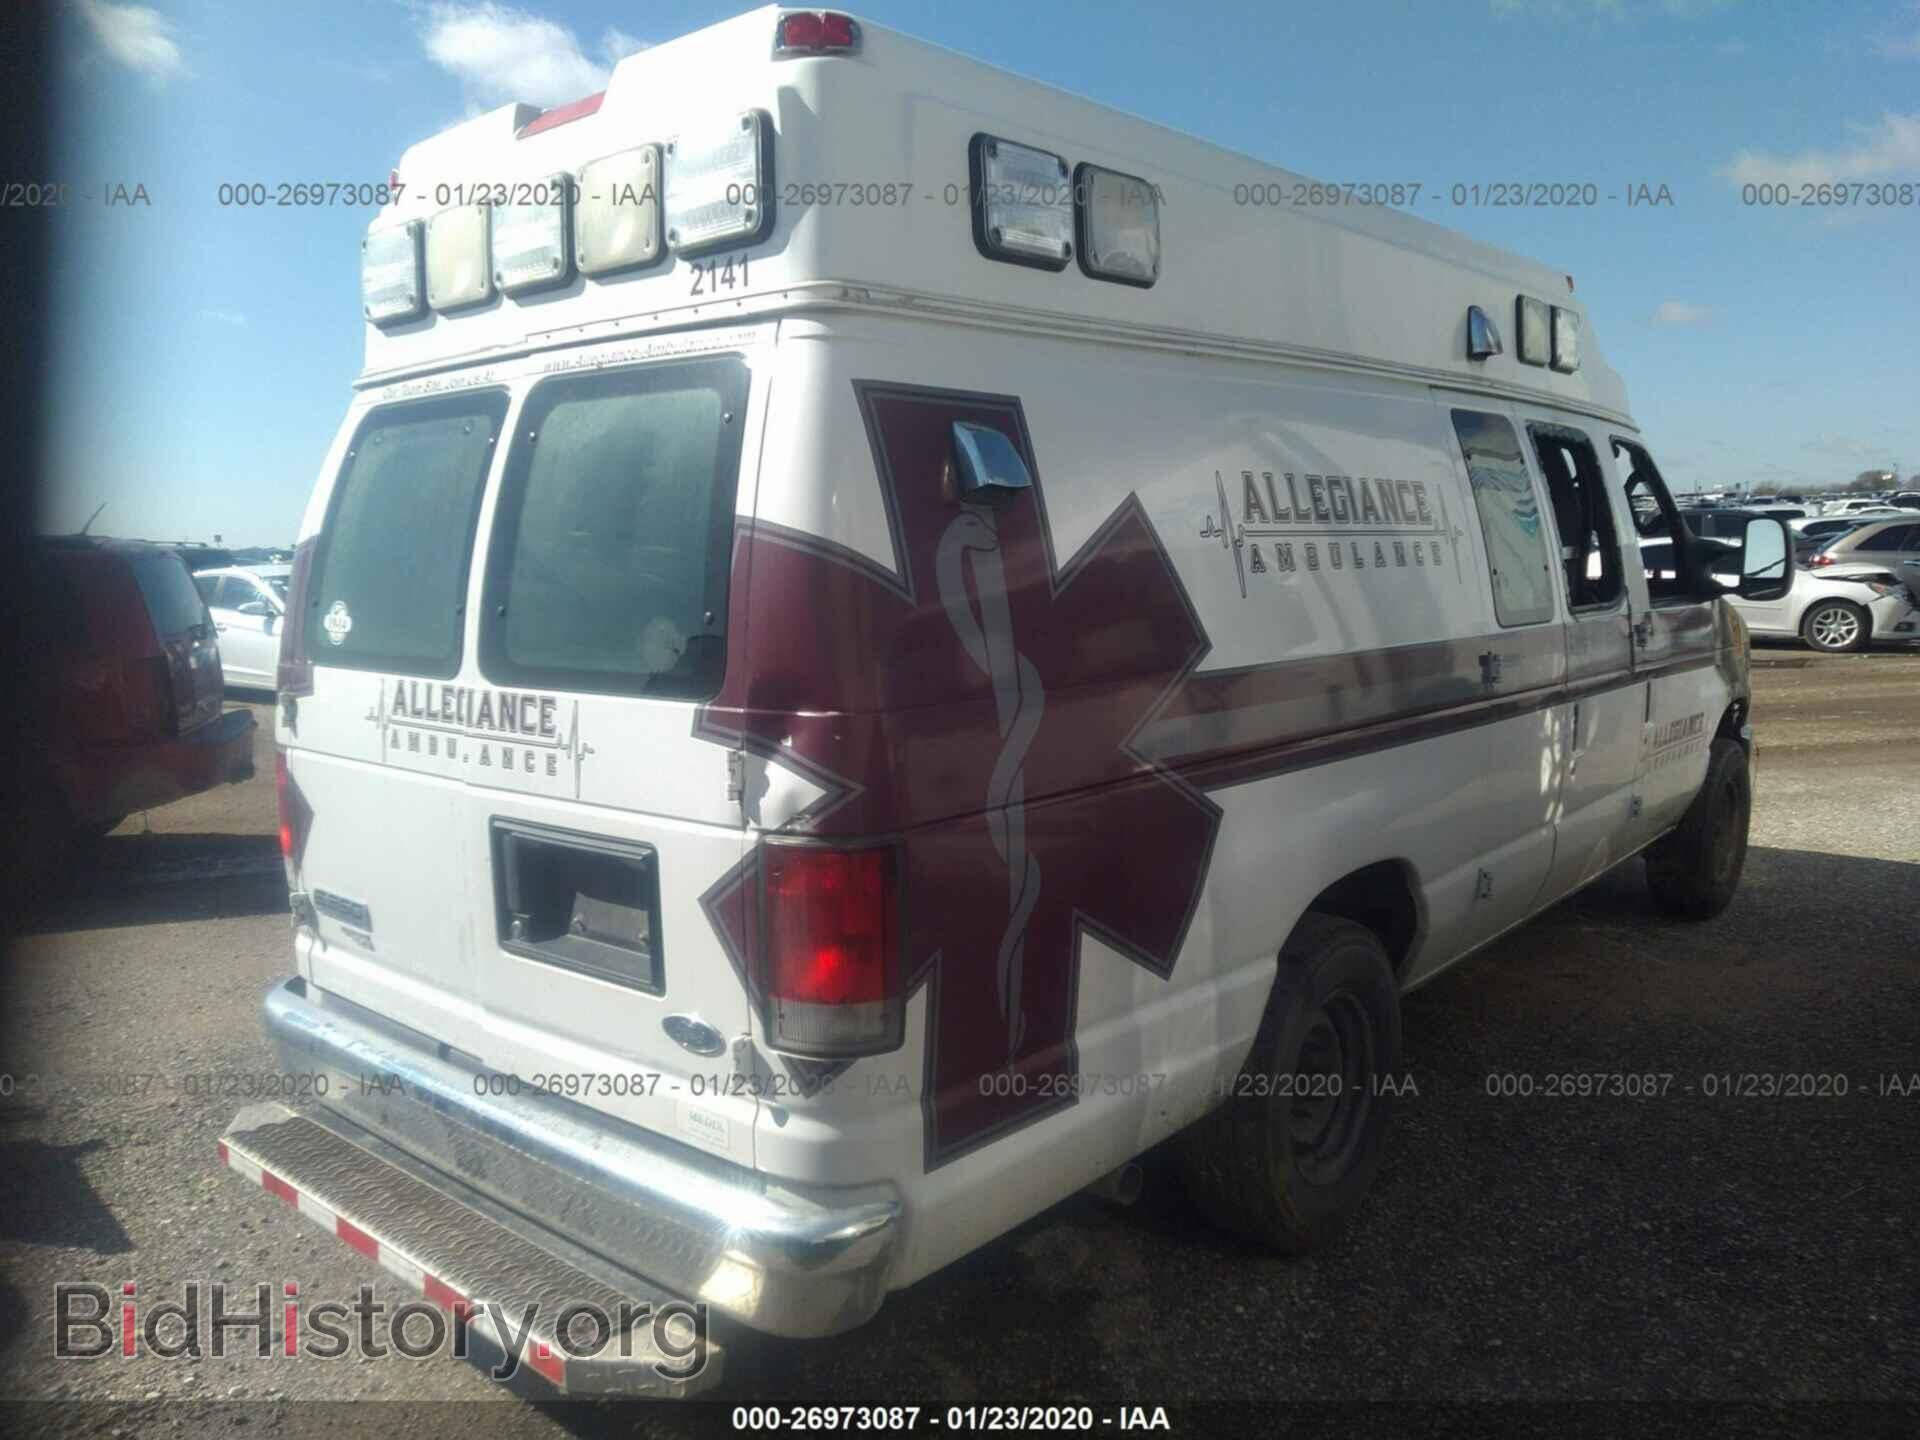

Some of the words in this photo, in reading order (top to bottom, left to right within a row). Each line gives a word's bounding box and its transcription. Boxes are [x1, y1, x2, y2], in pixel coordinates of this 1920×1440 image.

[689, 252, 749, 297] 2141
[1240, 470, 1433, 526] ALLEGIANCE
[1250, 540, 1442, 574] AMBULANCE
